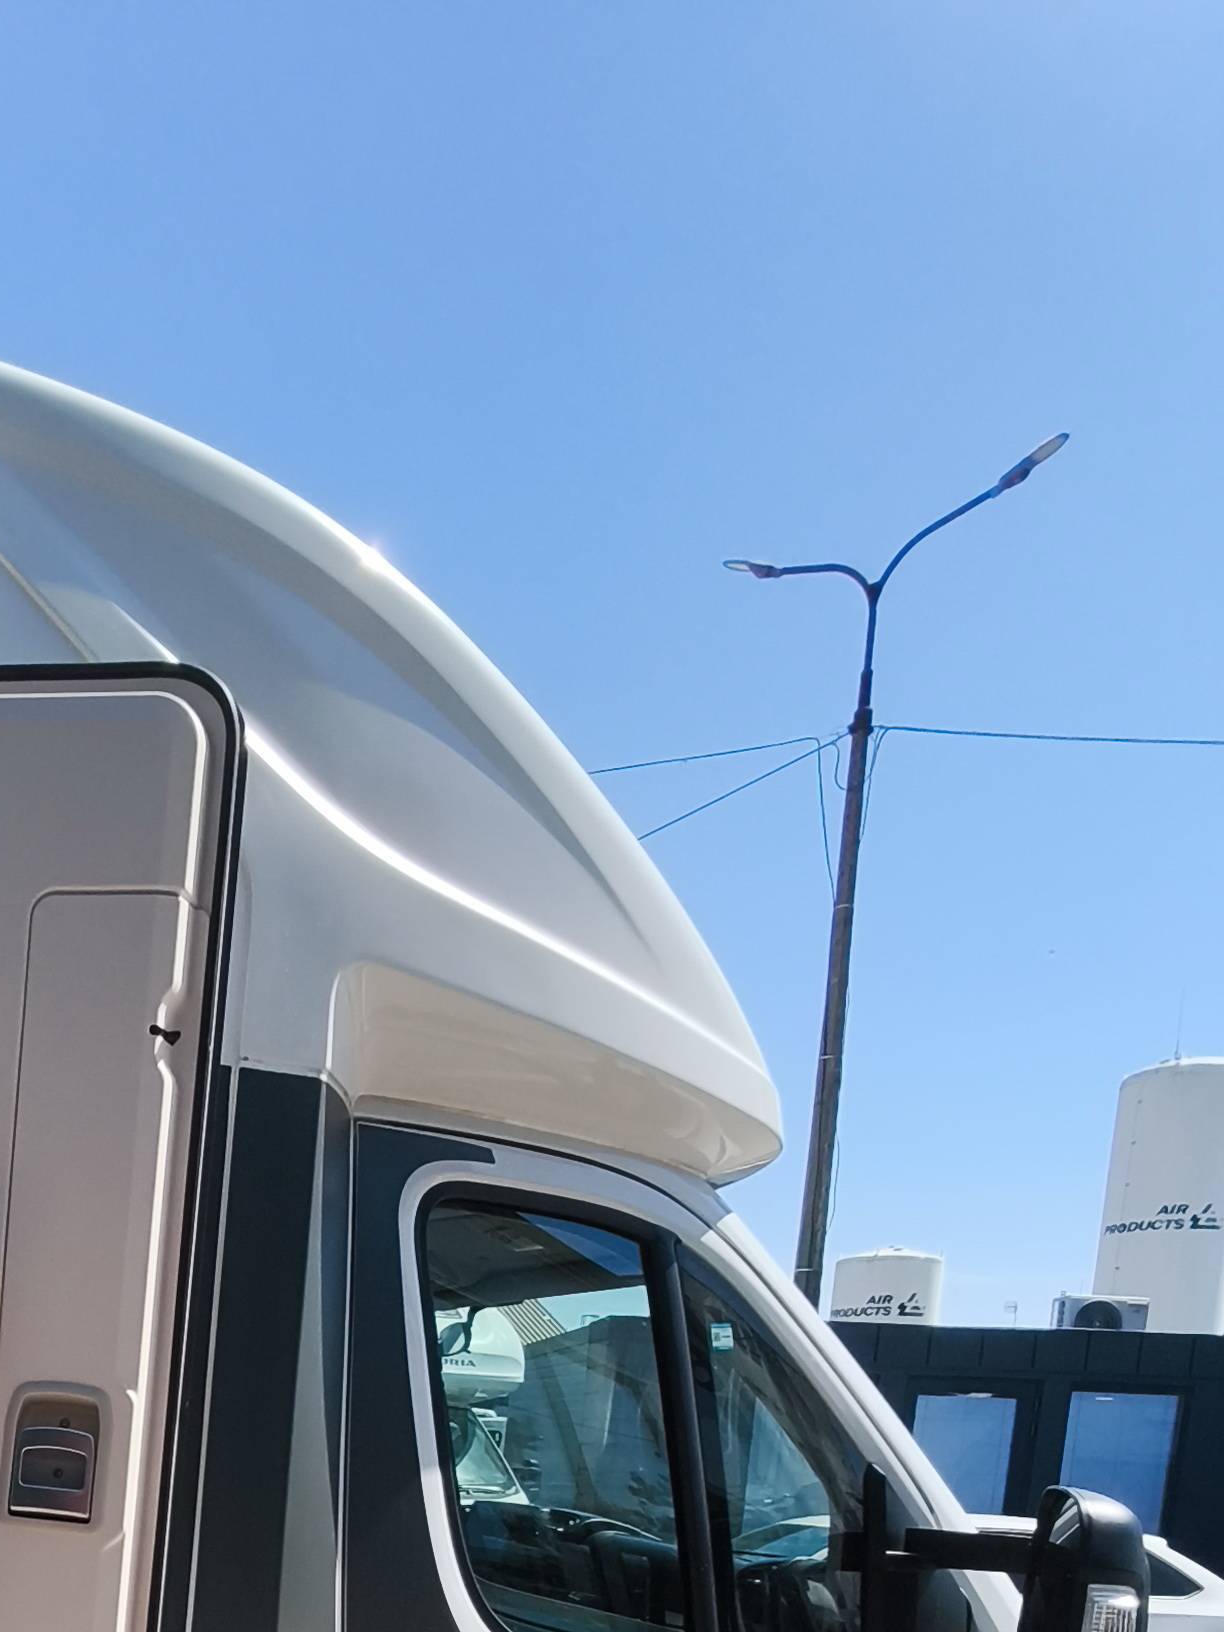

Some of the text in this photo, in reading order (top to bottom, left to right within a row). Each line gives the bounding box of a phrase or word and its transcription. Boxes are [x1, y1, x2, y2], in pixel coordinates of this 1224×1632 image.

[1156, 1203, 1190, 1216] AIR
[1104, 1218, 1185, 1235] PRODUCTS
[866, 1294, 894, 1305] AIR
